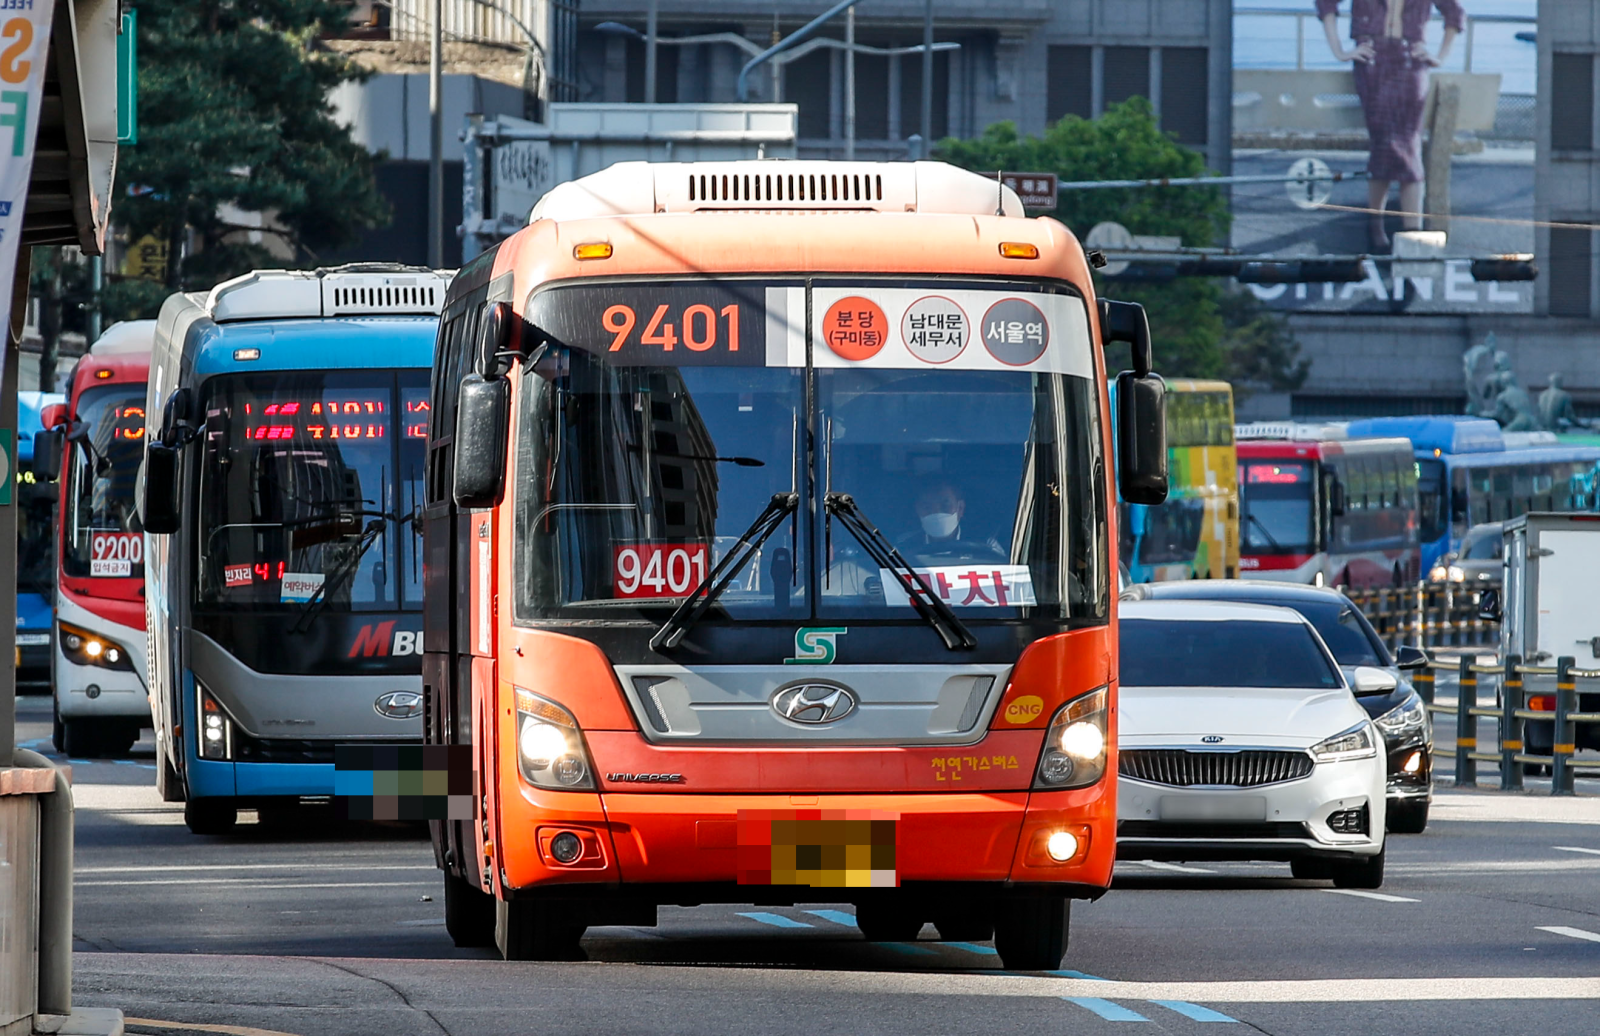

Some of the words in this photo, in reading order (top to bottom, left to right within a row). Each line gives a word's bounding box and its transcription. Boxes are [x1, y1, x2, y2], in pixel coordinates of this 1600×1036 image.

[602, 304, 739, 352] 9401
[836, 310, 874, 328] 분당
[909, 314, 963, 330] 남대문
[829, 330, 882, 347] (구미동)
[909, 331, 963, 348] 세무서
[987, 321, 1043, 345] 서울역
[93, 535, 142, 564] 9200
[93, 562, 129, 574] 입석금지
[224, 567, 252, 582] 빈자리
[254, 561, 285, 580] 41
[617, 548, 705, 594] 9401
[348, 620, 425, 658] MB
[1008, 705, 1041, 715] CNG
[605, 772, 682, 782] UNIVERSE
[931, 755, 1019, 781] 천연가스버스
